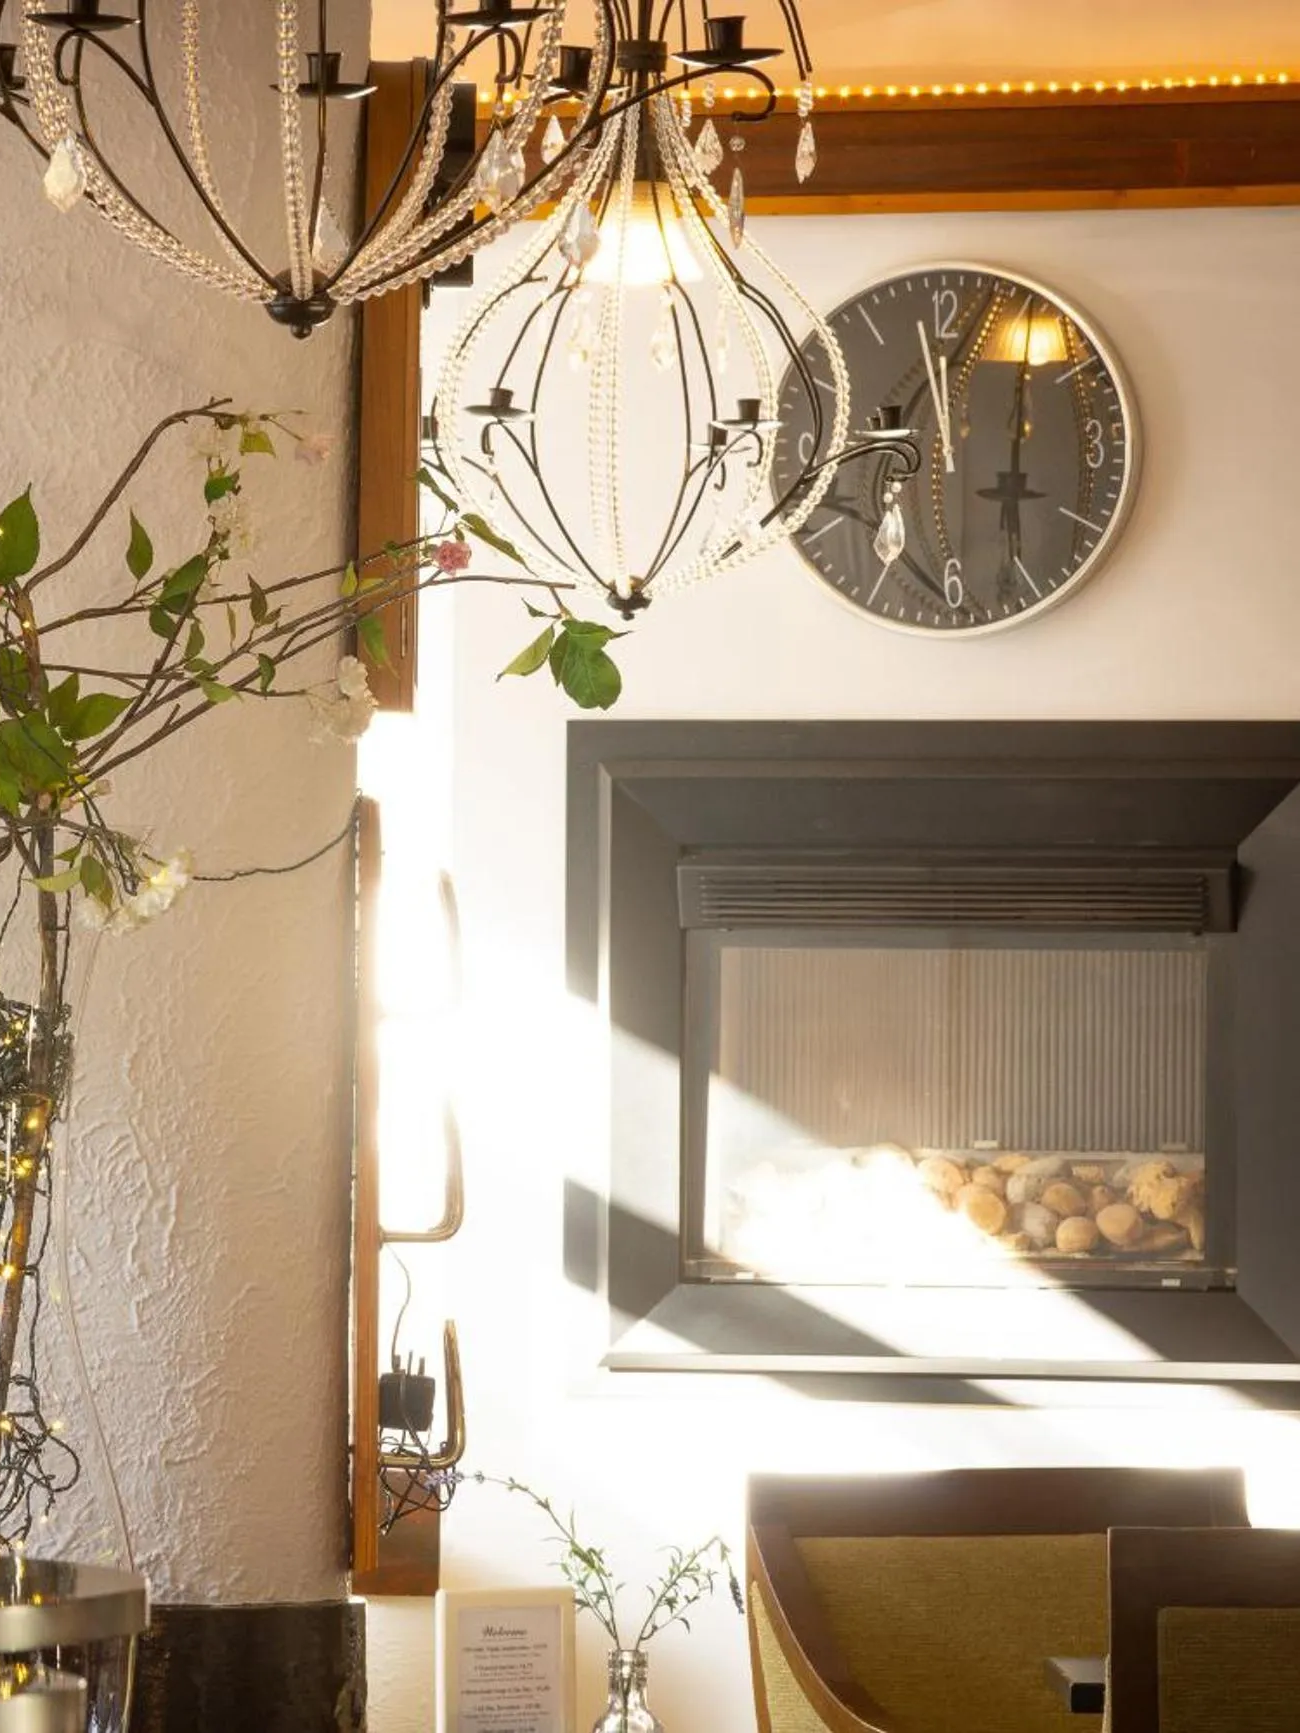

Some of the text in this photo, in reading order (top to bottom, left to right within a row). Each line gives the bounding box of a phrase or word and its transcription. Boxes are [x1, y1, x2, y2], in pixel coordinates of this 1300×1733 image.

[931, 289, 959, 339] 12
[1085, 419, 1104, 469] 3
[944, 558, 963, 608] 6
